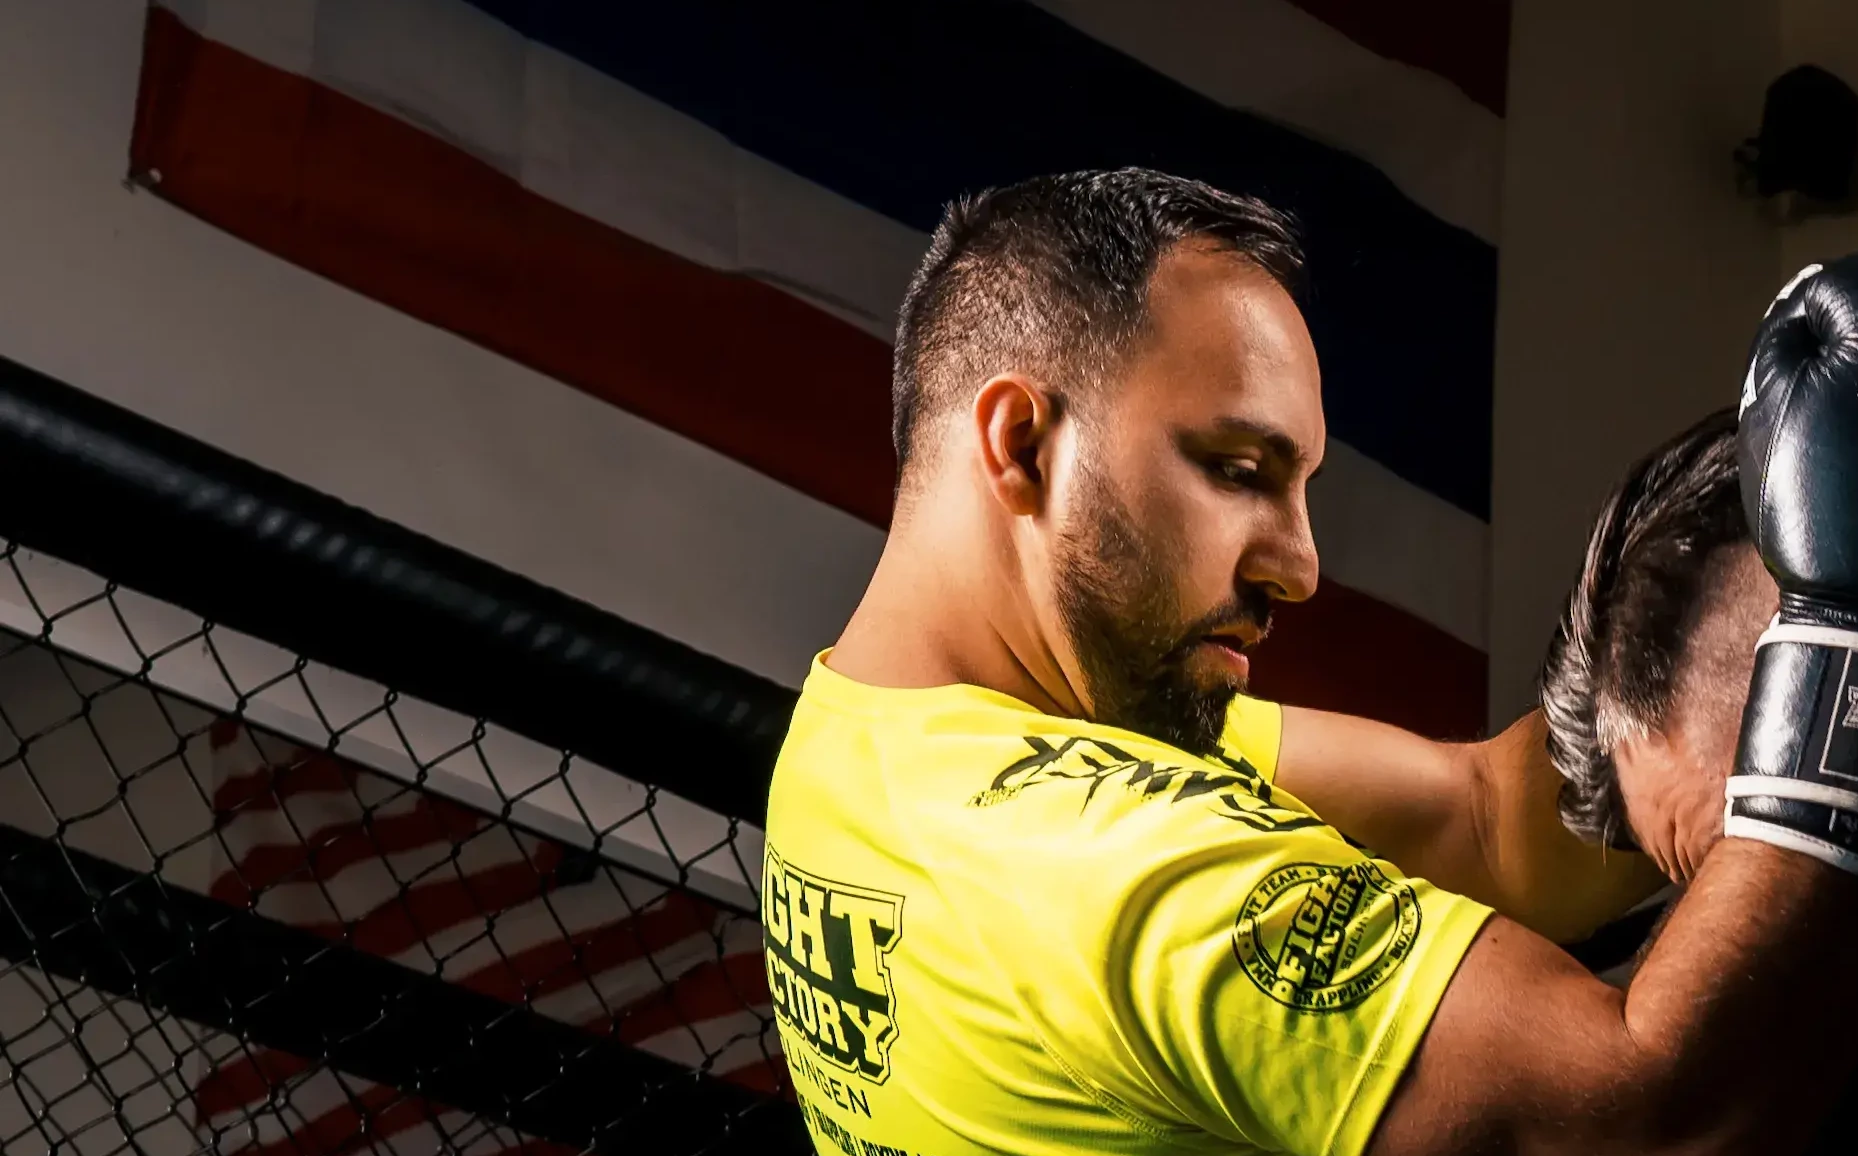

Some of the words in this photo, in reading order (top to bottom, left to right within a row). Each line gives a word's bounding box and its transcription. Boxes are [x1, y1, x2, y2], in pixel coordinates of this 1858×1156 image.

[765, 850, 896, 999] GHT
[1258, 867, 1301, 897] TEAM
[766, 946, 893, 1068] CTORY
